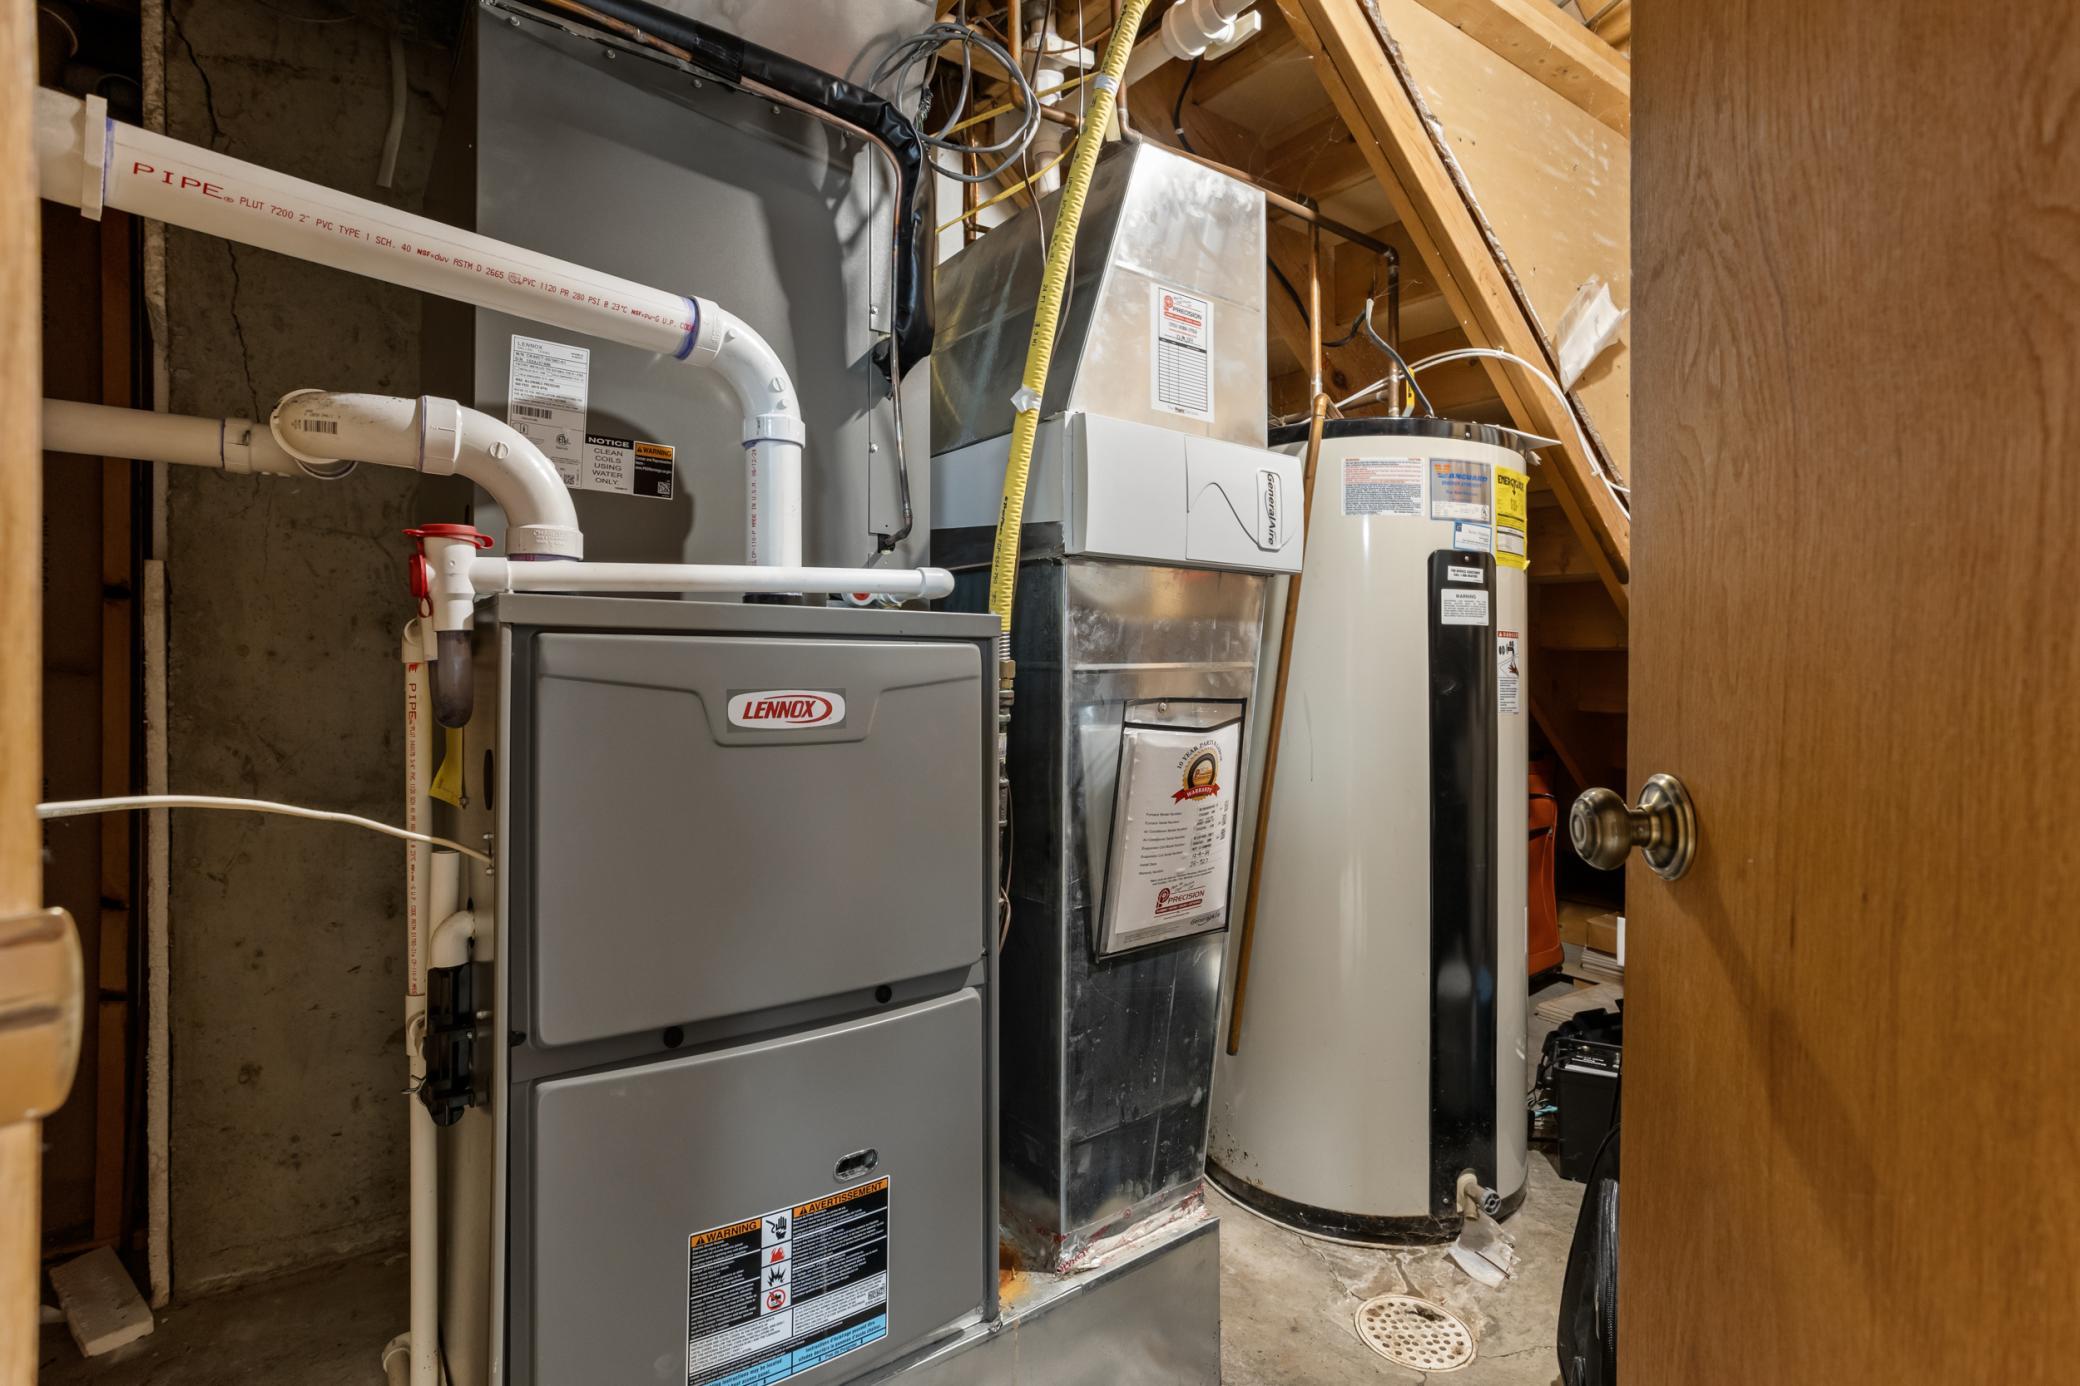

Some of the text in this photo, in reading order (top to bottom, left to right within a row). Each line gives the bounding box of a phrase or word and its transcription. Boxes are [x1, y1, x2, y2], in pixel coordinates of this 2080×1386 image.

[239, 196, 264, 211] PLUT
[270, 205, 294, 220] 7200
[315, 218, 333, 231] PVC
[339, 224, 361, 239] TYPE
[401, 243, 412, 253] 40
[453, 258, 473, 270] ASTM
[476, 264, 482, 272] D
[485, 268, 505, 279] 2665
[522, 277, 537, 288] PVC
[559, 287, 570, 297] PR
[587, 296, 601, 306] PSI
[588, 436, 630, 448] NOTICE
[593, 447, 623, 457] CLEAN
[642, 446, 672, 457] WARNING
[594, 455, 622, 465] COILS
[594, 462, 622, 472] USING
[592, 469, 623, 479] WATER
[595, 477, 618, 485] ONLY
[1267, 473, 1276, 545] GeneralAire
[408, 683, 417, 721] PIPE
[742, 700, 816, 720] LENNOX
[1168, 889, 1205, 904] PRECISION
[808, 1181, 883, 1213] AVERTISSEMENT
[706, 1221, 757, 1242] WARNING
